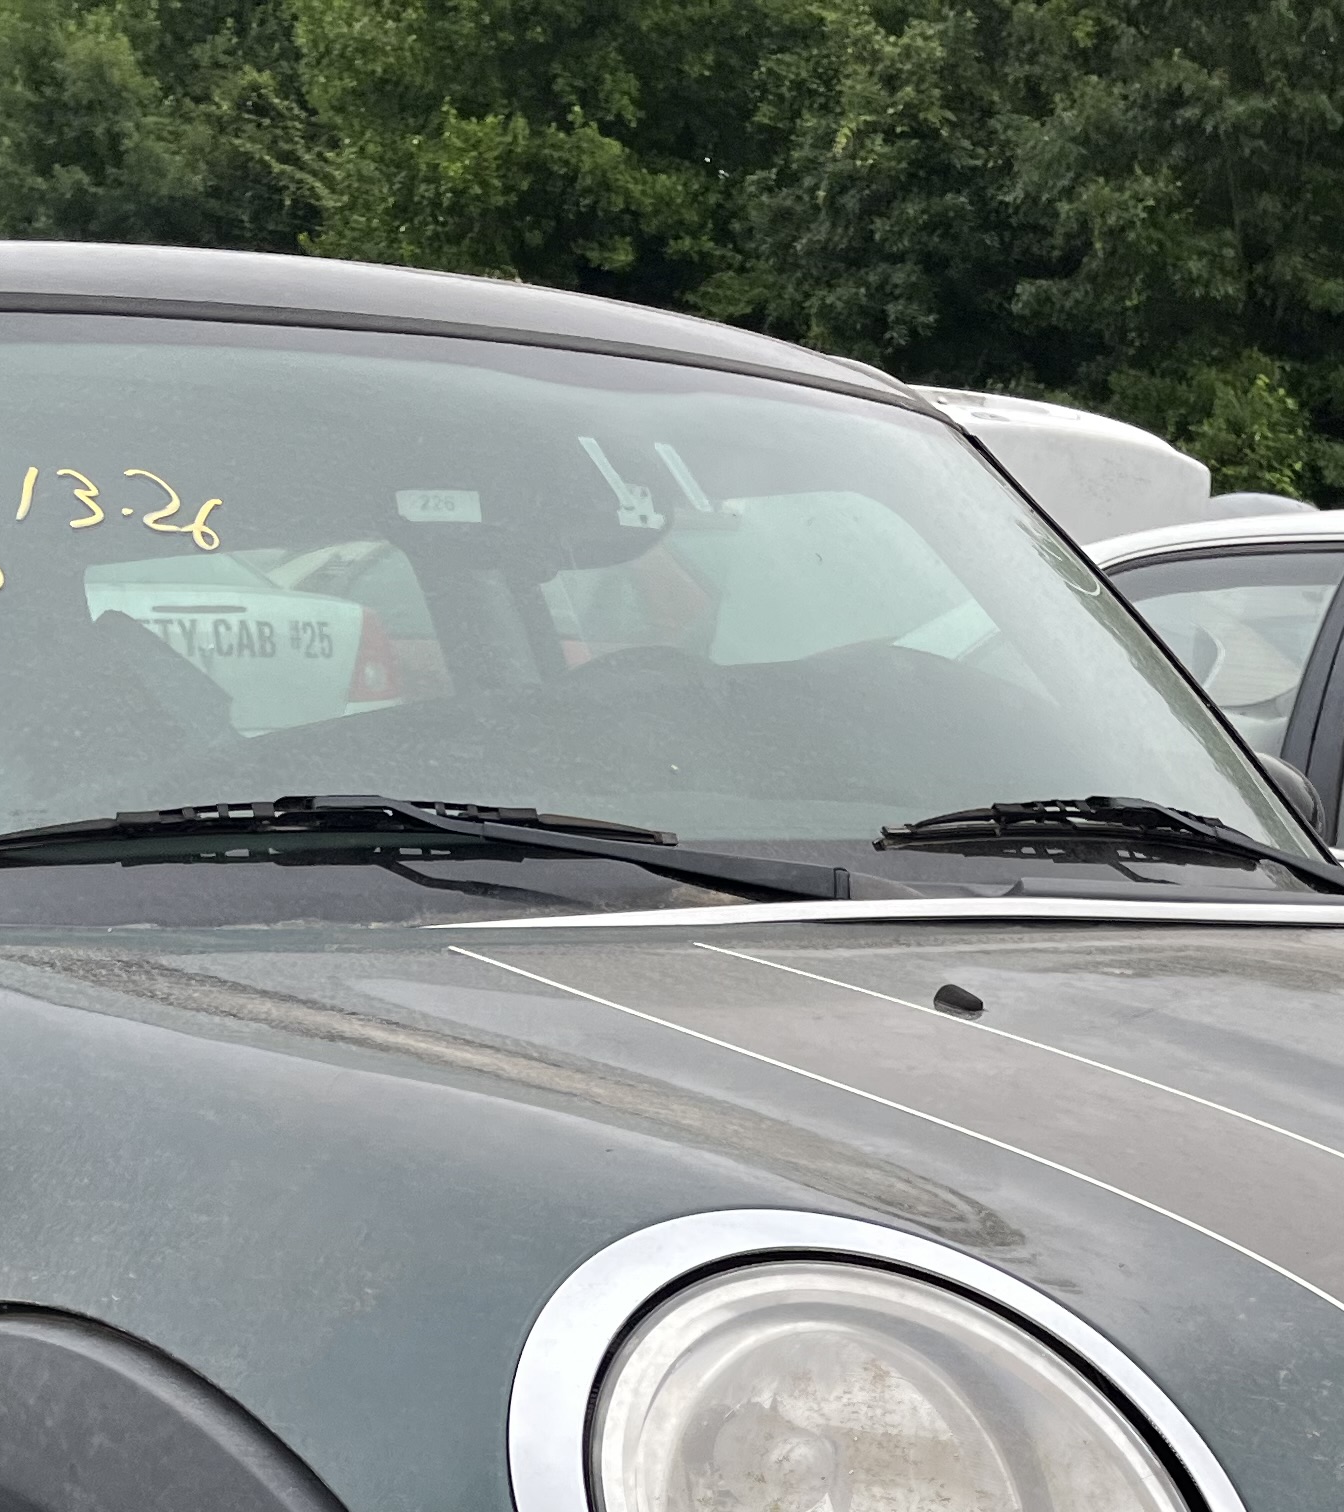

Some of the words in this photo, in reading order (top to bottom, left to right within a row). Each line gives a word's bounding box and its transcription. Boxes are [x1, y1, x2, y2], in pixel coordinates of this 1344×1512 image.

[137, 618, 197, 657] TY
[212, 618, 277, 658] CAB
[290, 620, 334, 659] #25
